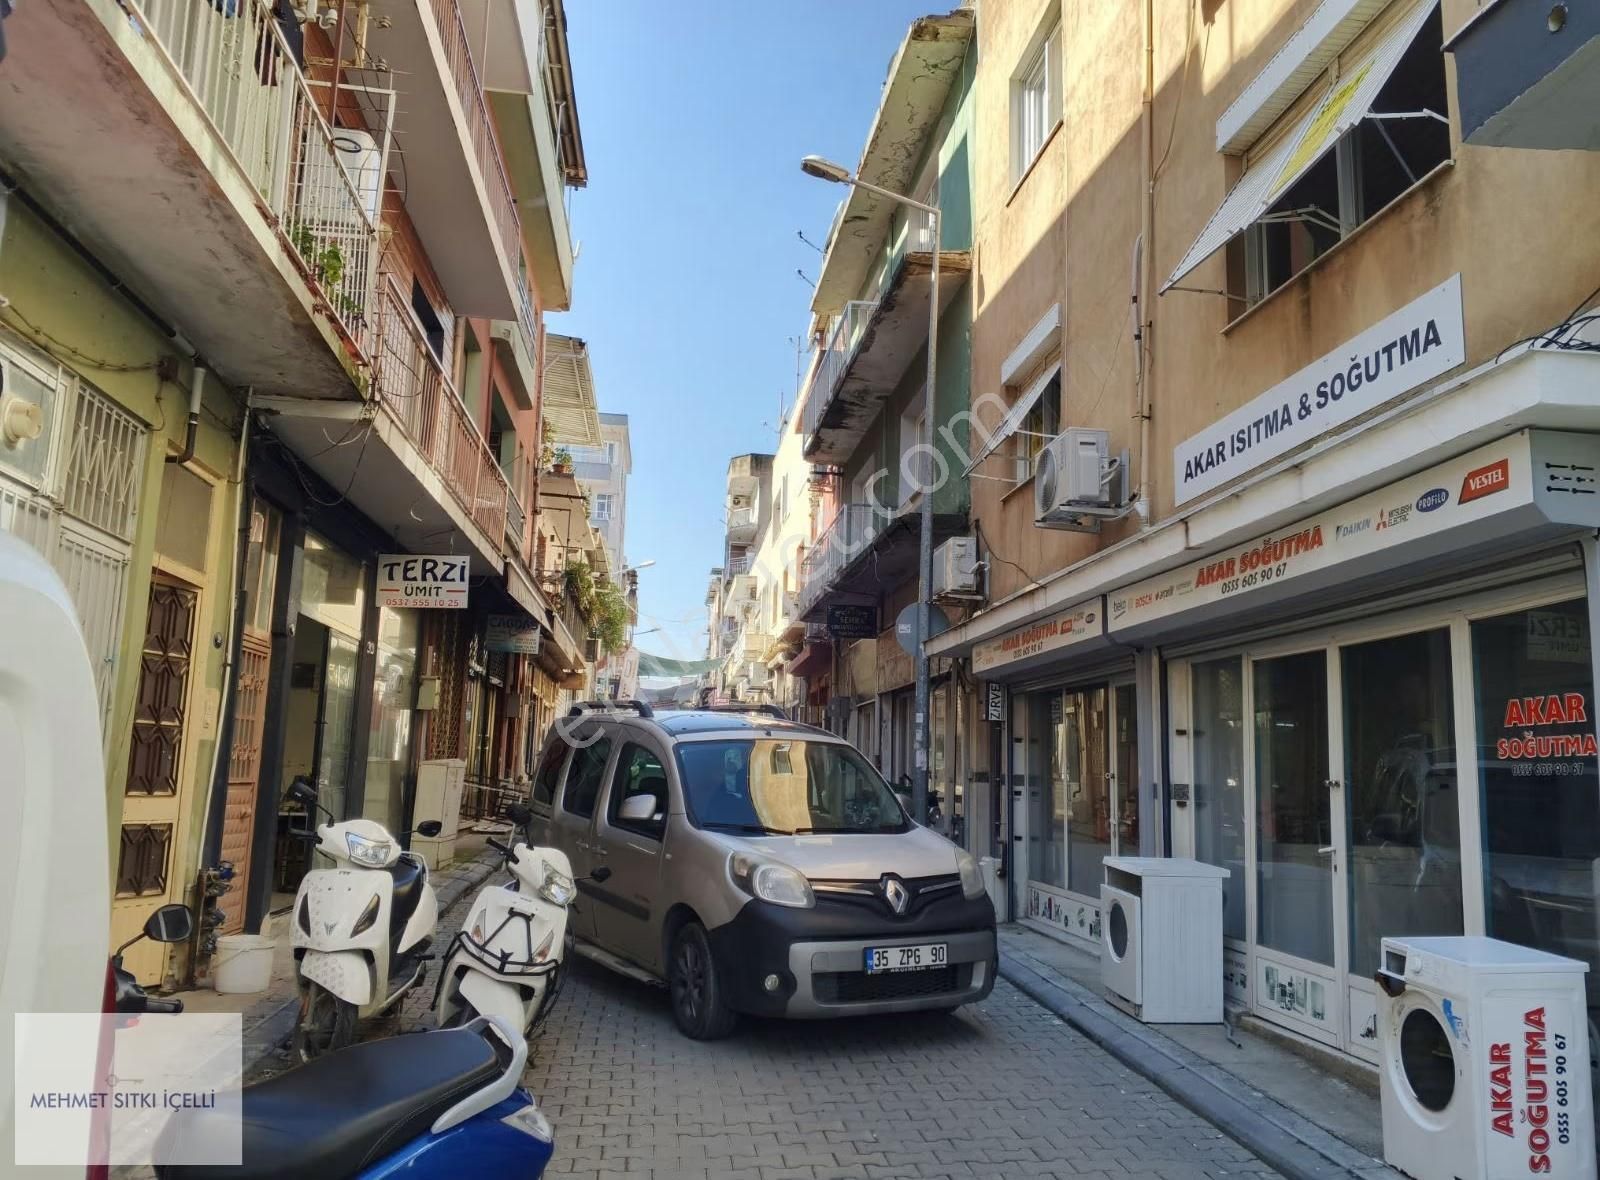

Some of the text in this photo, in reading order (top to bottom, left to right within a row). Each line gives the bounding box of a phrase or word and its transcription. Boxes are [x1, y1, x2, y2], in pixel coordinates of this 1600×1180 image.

[1184, 318, 1442, 483] AKAR ISITMA & SOĞUTMA
[1469, 469, 1505, 491] VESTEL
[1342, 518, 1371, 537] DAIKIN
[1195, 557, 1236, 588] AKAR
[1239, 525, 1323, 573] SOĞUTMA
[404, 584, 443, 597] ÜMİT
[1221, 562, 1287, 594] 0555 605 90 67
[385, 598, 460, 607] 0537 555 10 25
[1002, 633, 1022, 652] AKAR
[1504, 692, 1588, 727] AKAR
[1497, 730, 1598, 760] SOĞUTMA
[1555, 763, 1569, 776] 90
[1572, 762, 1584, 776] 67
[874, 946, 945, 968] 35 ZPG 90
[1489, 1042, 1515, 1139] AKAR
[1520, 1006, 1552, 1174] SOĞUTMA
[1554, 1033, 1570, 1144] 0555 605 90 67
